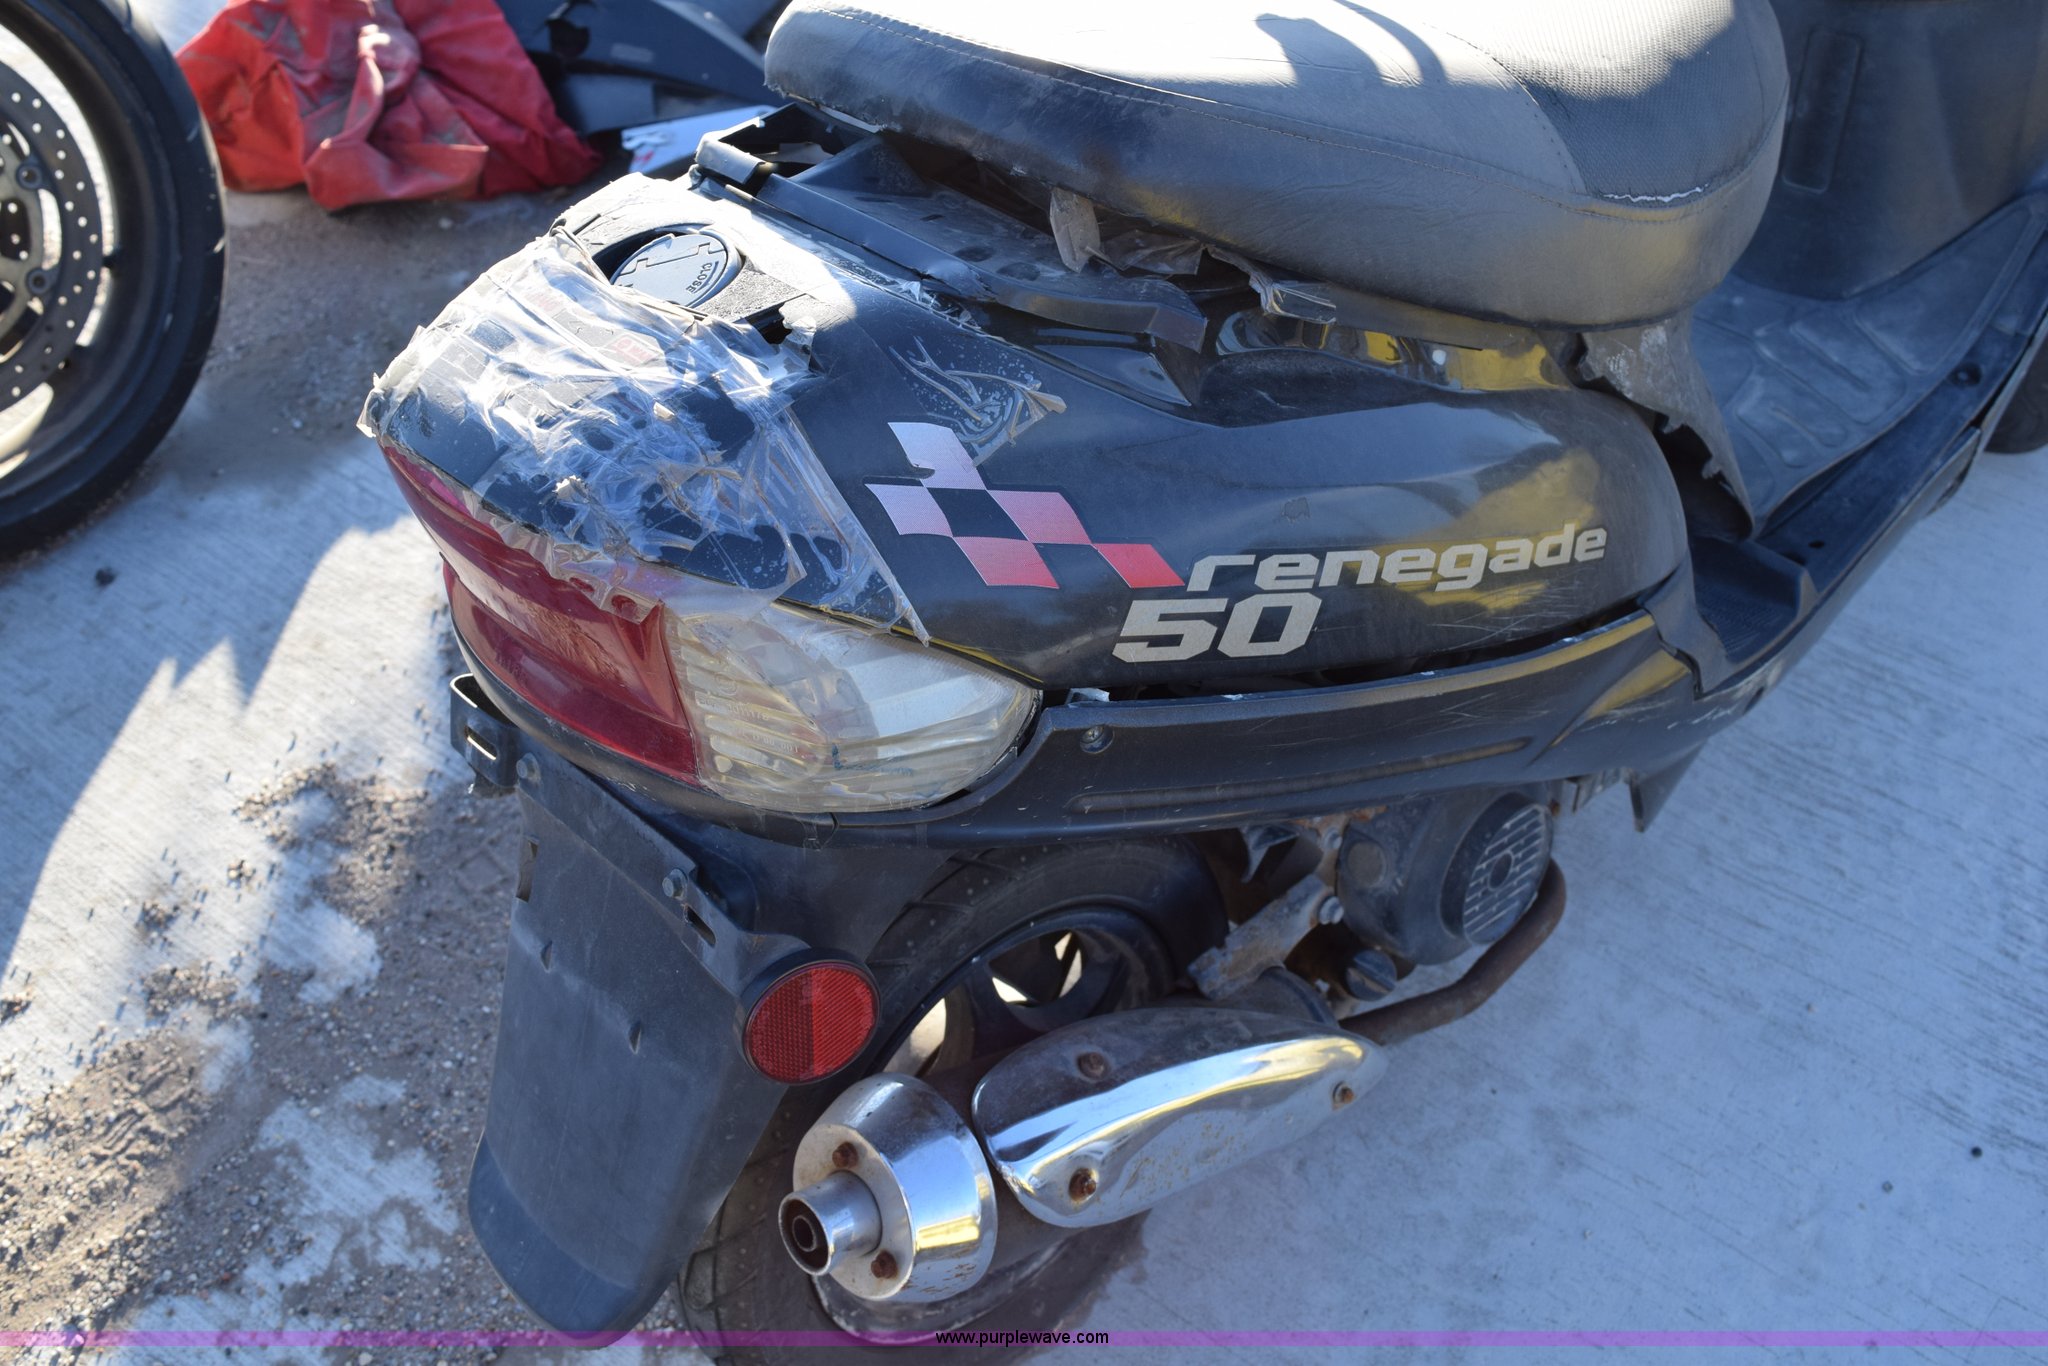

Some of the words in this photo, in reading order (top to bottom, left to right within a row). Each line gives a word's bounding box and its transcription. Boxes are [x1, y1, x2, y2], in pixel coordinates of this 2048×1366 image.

[685, 262, 713, 294] CLOSE
[1187, 523, 1607, 592] renegade
[1112, 592, 1322, 663] 50
